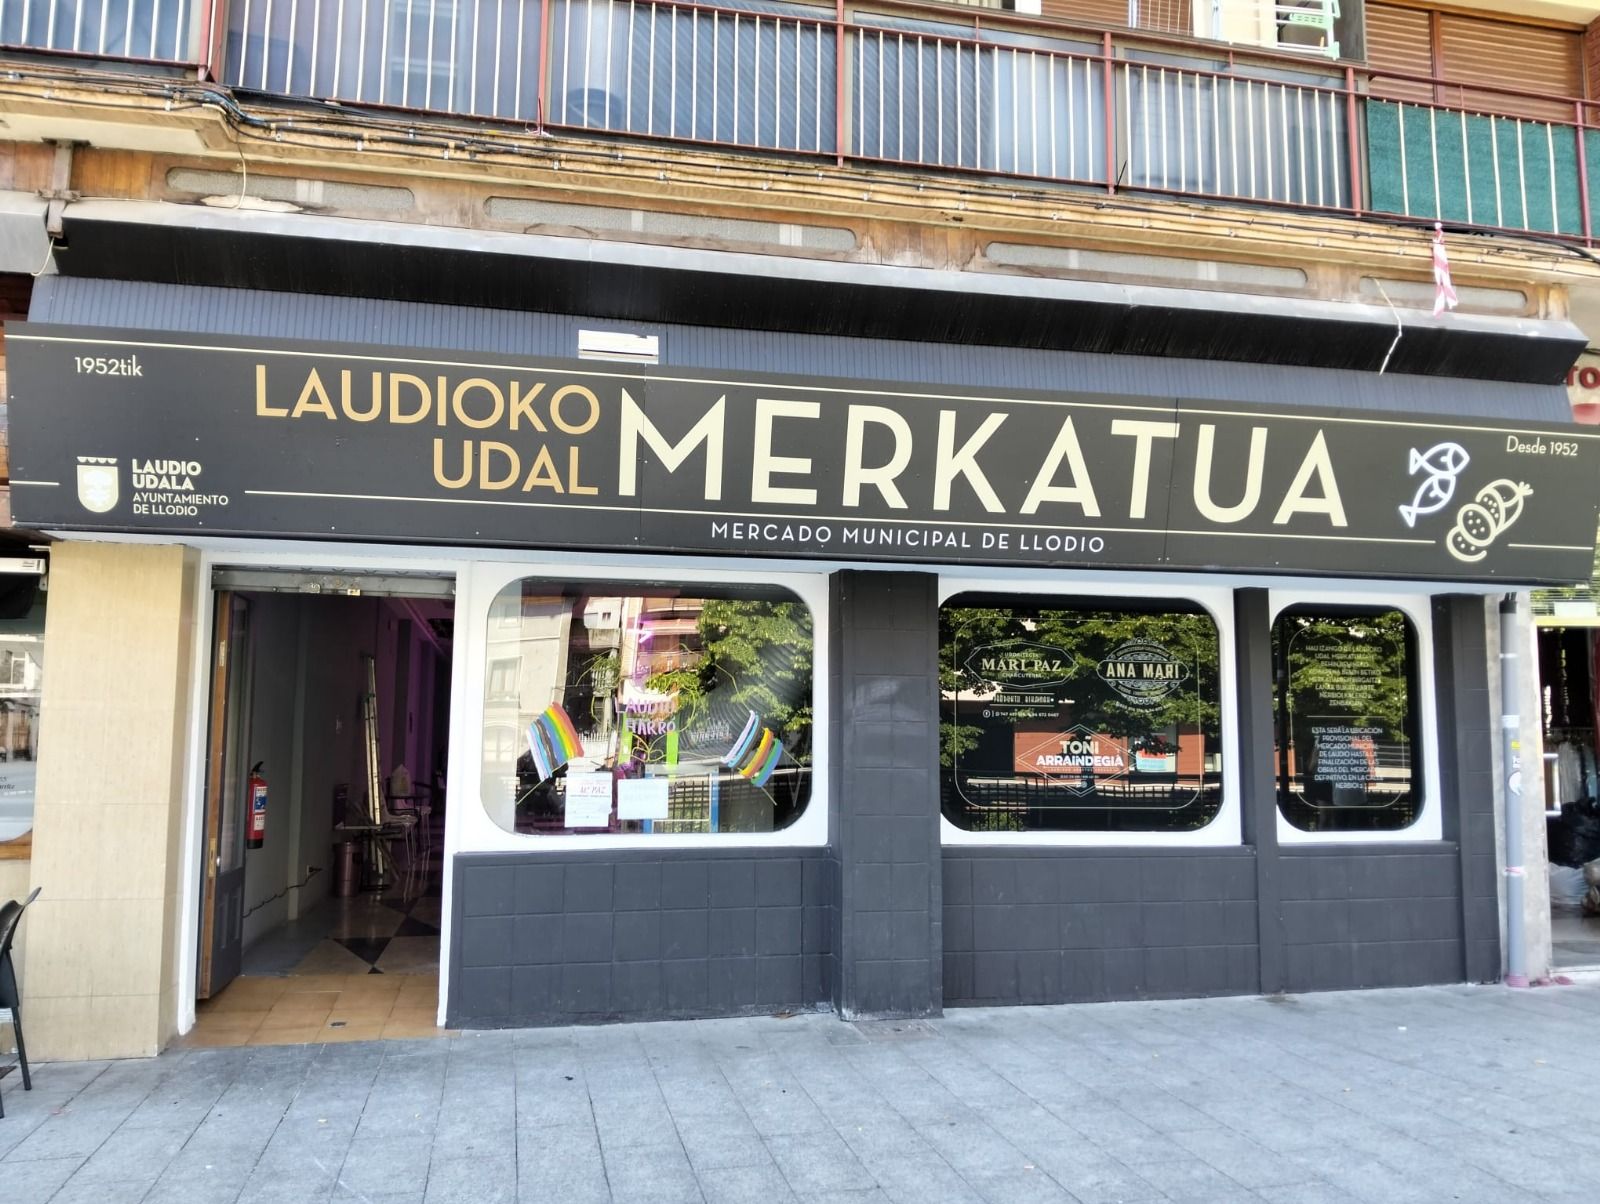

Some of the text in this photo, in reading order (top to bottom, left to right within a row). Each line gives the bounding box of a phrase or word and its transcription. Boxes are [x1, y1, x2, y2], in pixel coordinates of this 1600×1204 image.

[74, 354, 143, 376] 1952tik
[256, 364, 600, 435] LAUDIOKO
[1506, 435, 1578, 456] Desde 1952
[618, 387, 1348, 528] MERKATUA
[132, 458, 202, 476] LAUDIO
[433, 438, 599, 496] UDAL
[132, 473, 195, 491] UDALA
[132, 492, 229, 506] AYUNTAMIENTO
[133, 503, 198, 516] DE LLODIO
[711, 521, 1104, 552] MERCADO MUNICIPAL DE LLODIO
[981, 658, 1062, 672] MARI PAZ
[1106, 662, 1179, 679] ANA MARI
[1059, 736, 1100, 755] TOÑI
[1036, 755, 1124, 767] ARRAINDEGIA
